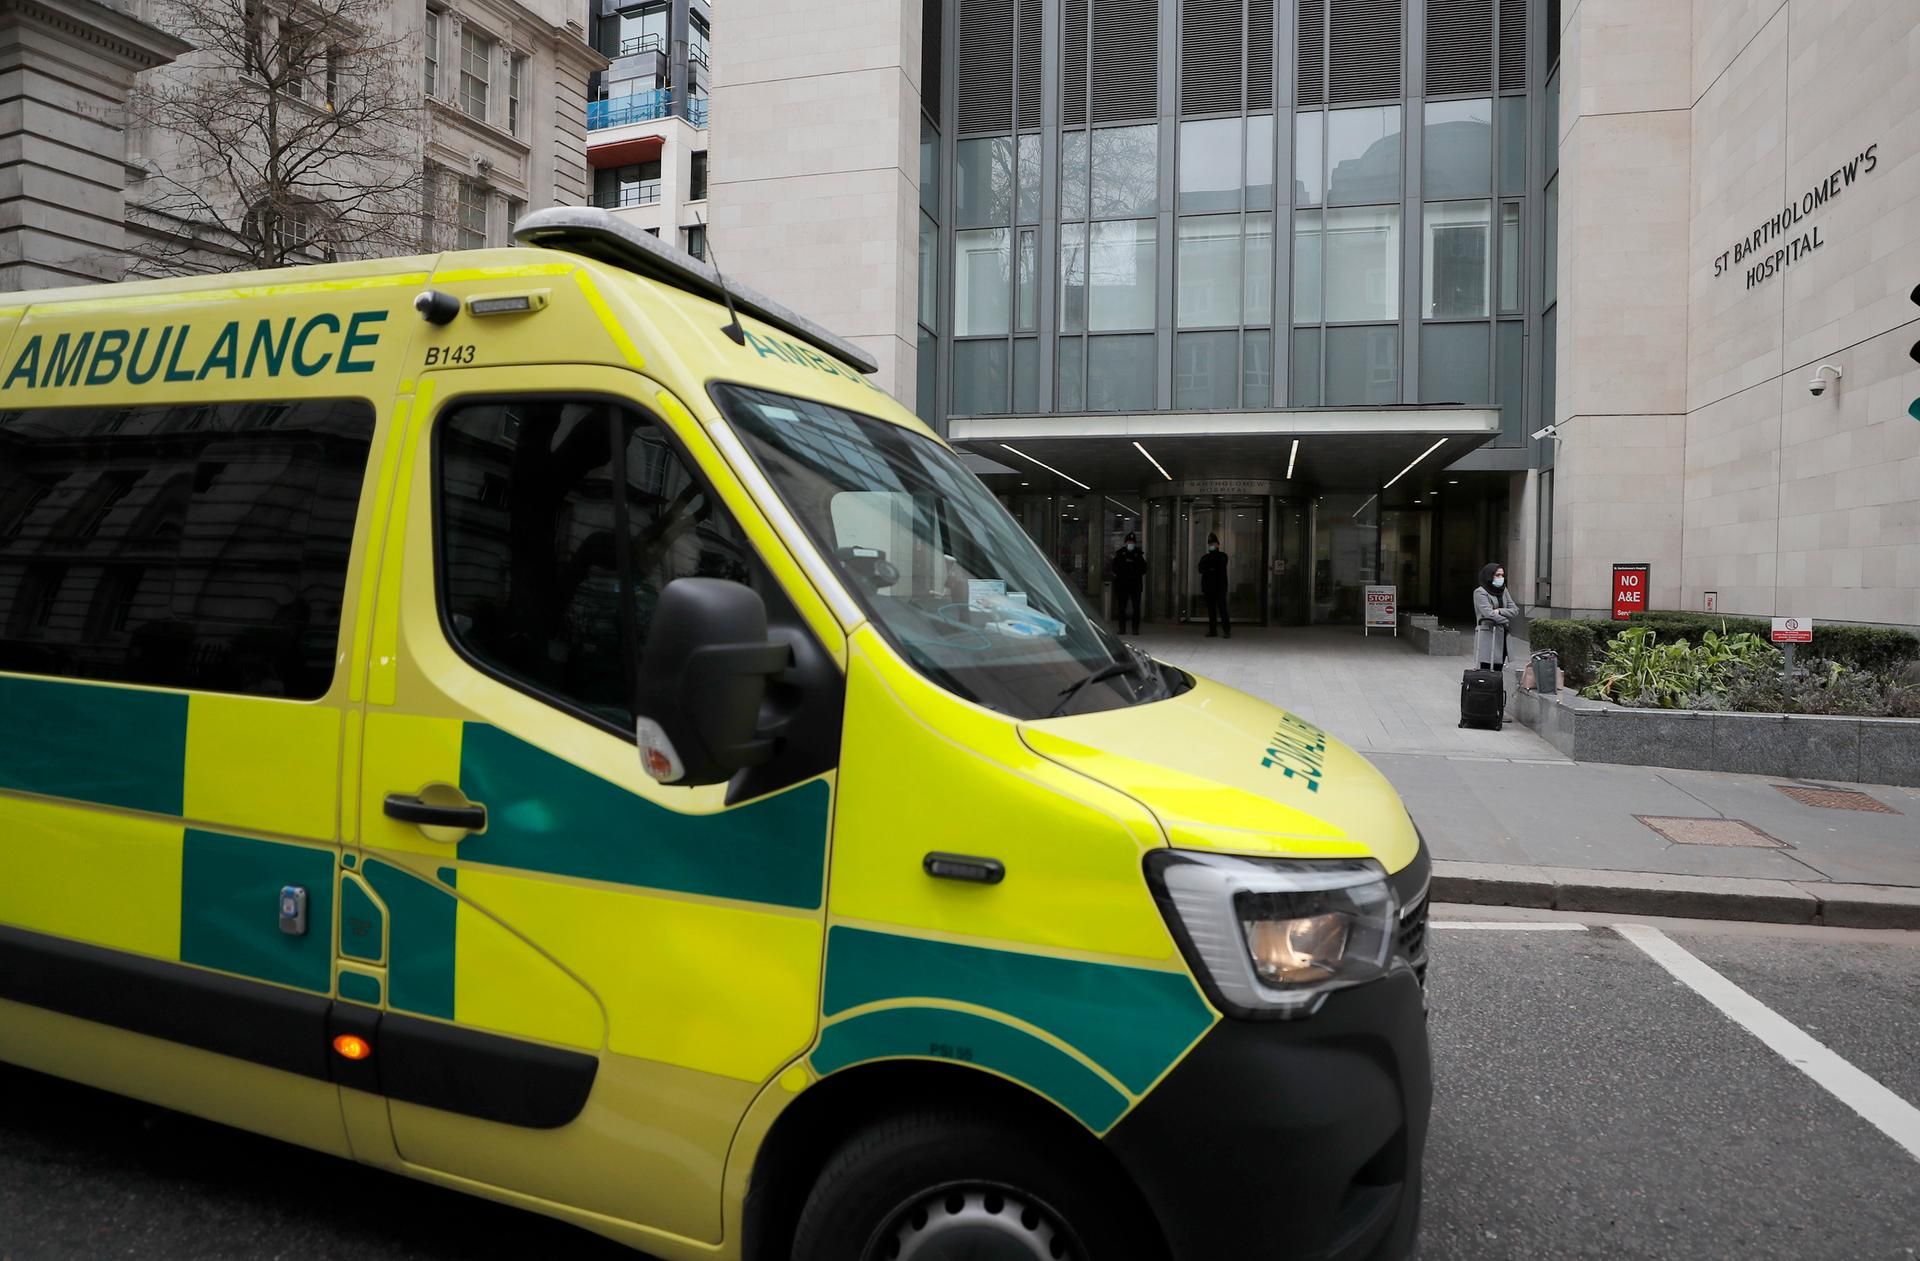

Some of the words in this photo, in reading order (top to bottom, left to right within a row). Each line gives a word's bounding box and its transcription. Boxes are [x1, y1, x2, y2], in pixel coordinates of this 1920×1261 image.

[1714, 251, 1730, 277] ST
[1734, 143, 1877, 264] BARTHOLOMEW'S
[1746, 226, 1824, 290] HOSPITAL
[2, 310, 389, 390] AMBULANCE
[424, 345, 476, 366] B143
[1621, 575, 1639, 587] NO
[1368, 594, 1393, 602] STOP!
[1617, 591, 1641, 603] A&E
